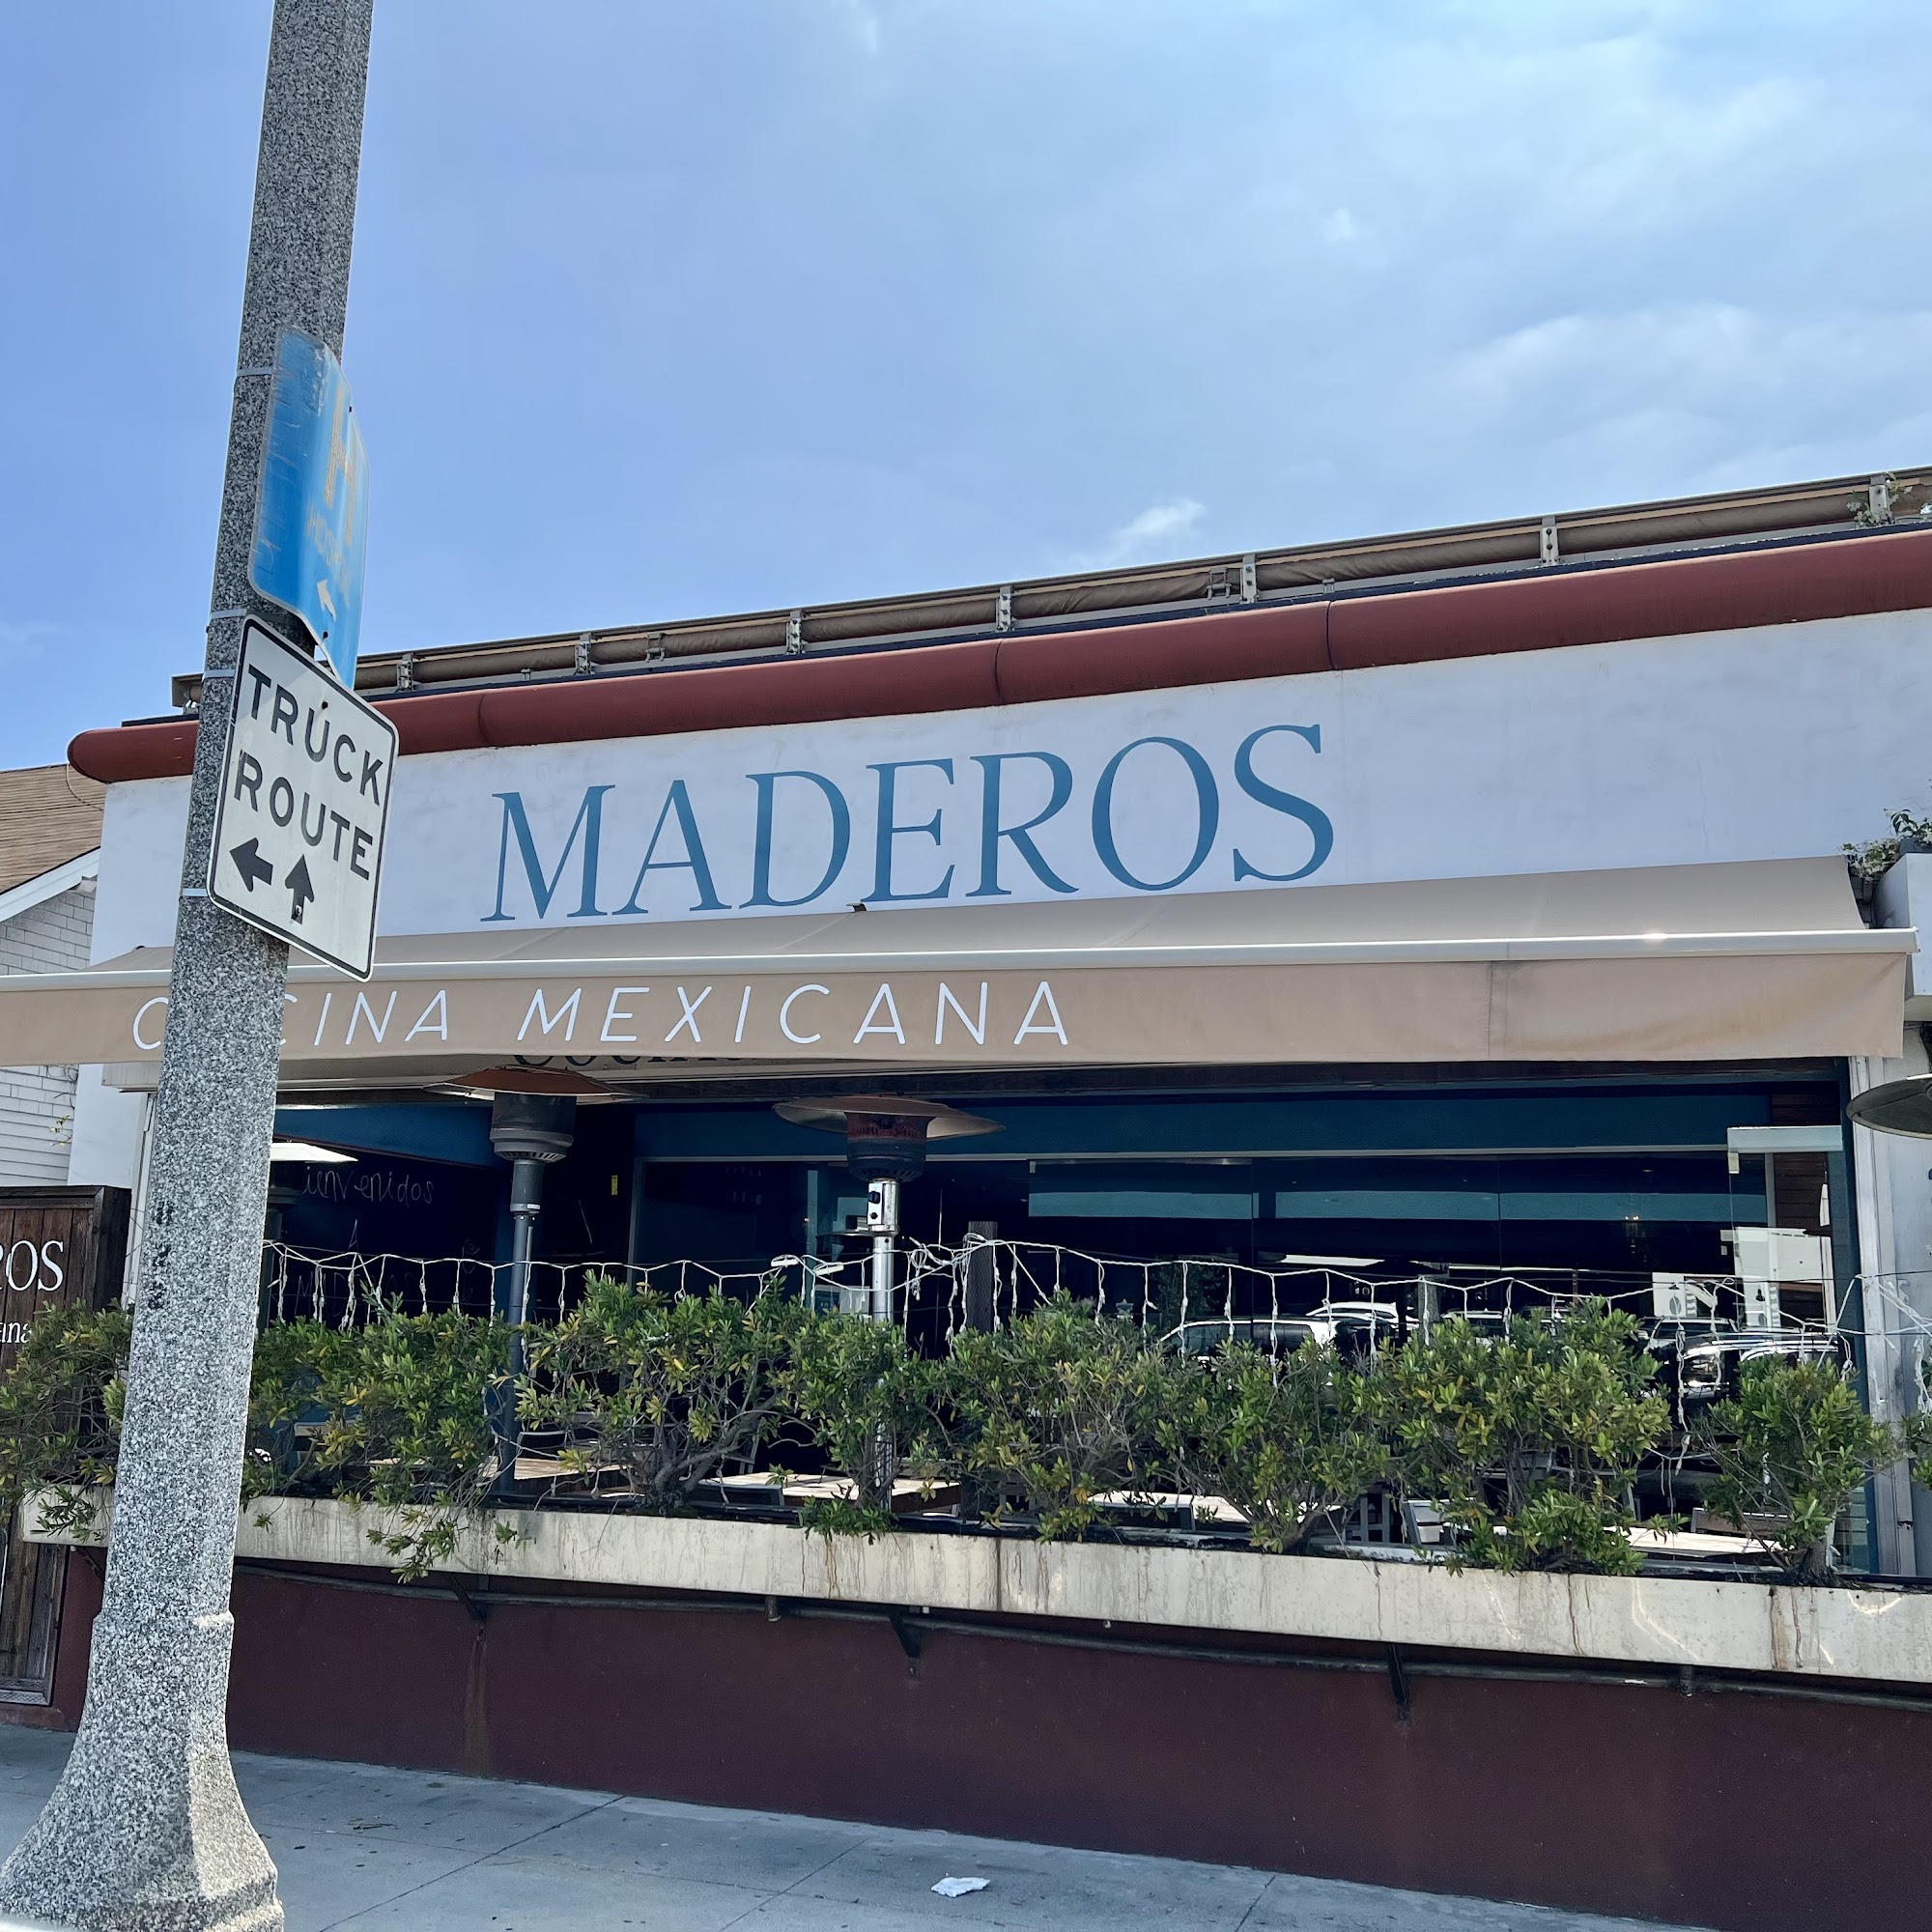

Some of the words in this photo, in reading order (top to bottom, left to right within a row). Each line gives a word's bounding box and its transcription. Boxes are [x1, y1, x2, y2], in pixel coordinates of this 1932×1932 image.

[247, 663, 384, 808] TRUCK
[234, 749, 374, 881] ROUTE
[479, 723, 1335, 923] MADEROS
[131, 989, 448, 1050] CINA
[517, 980, 1069, 1046] MEXICANA
